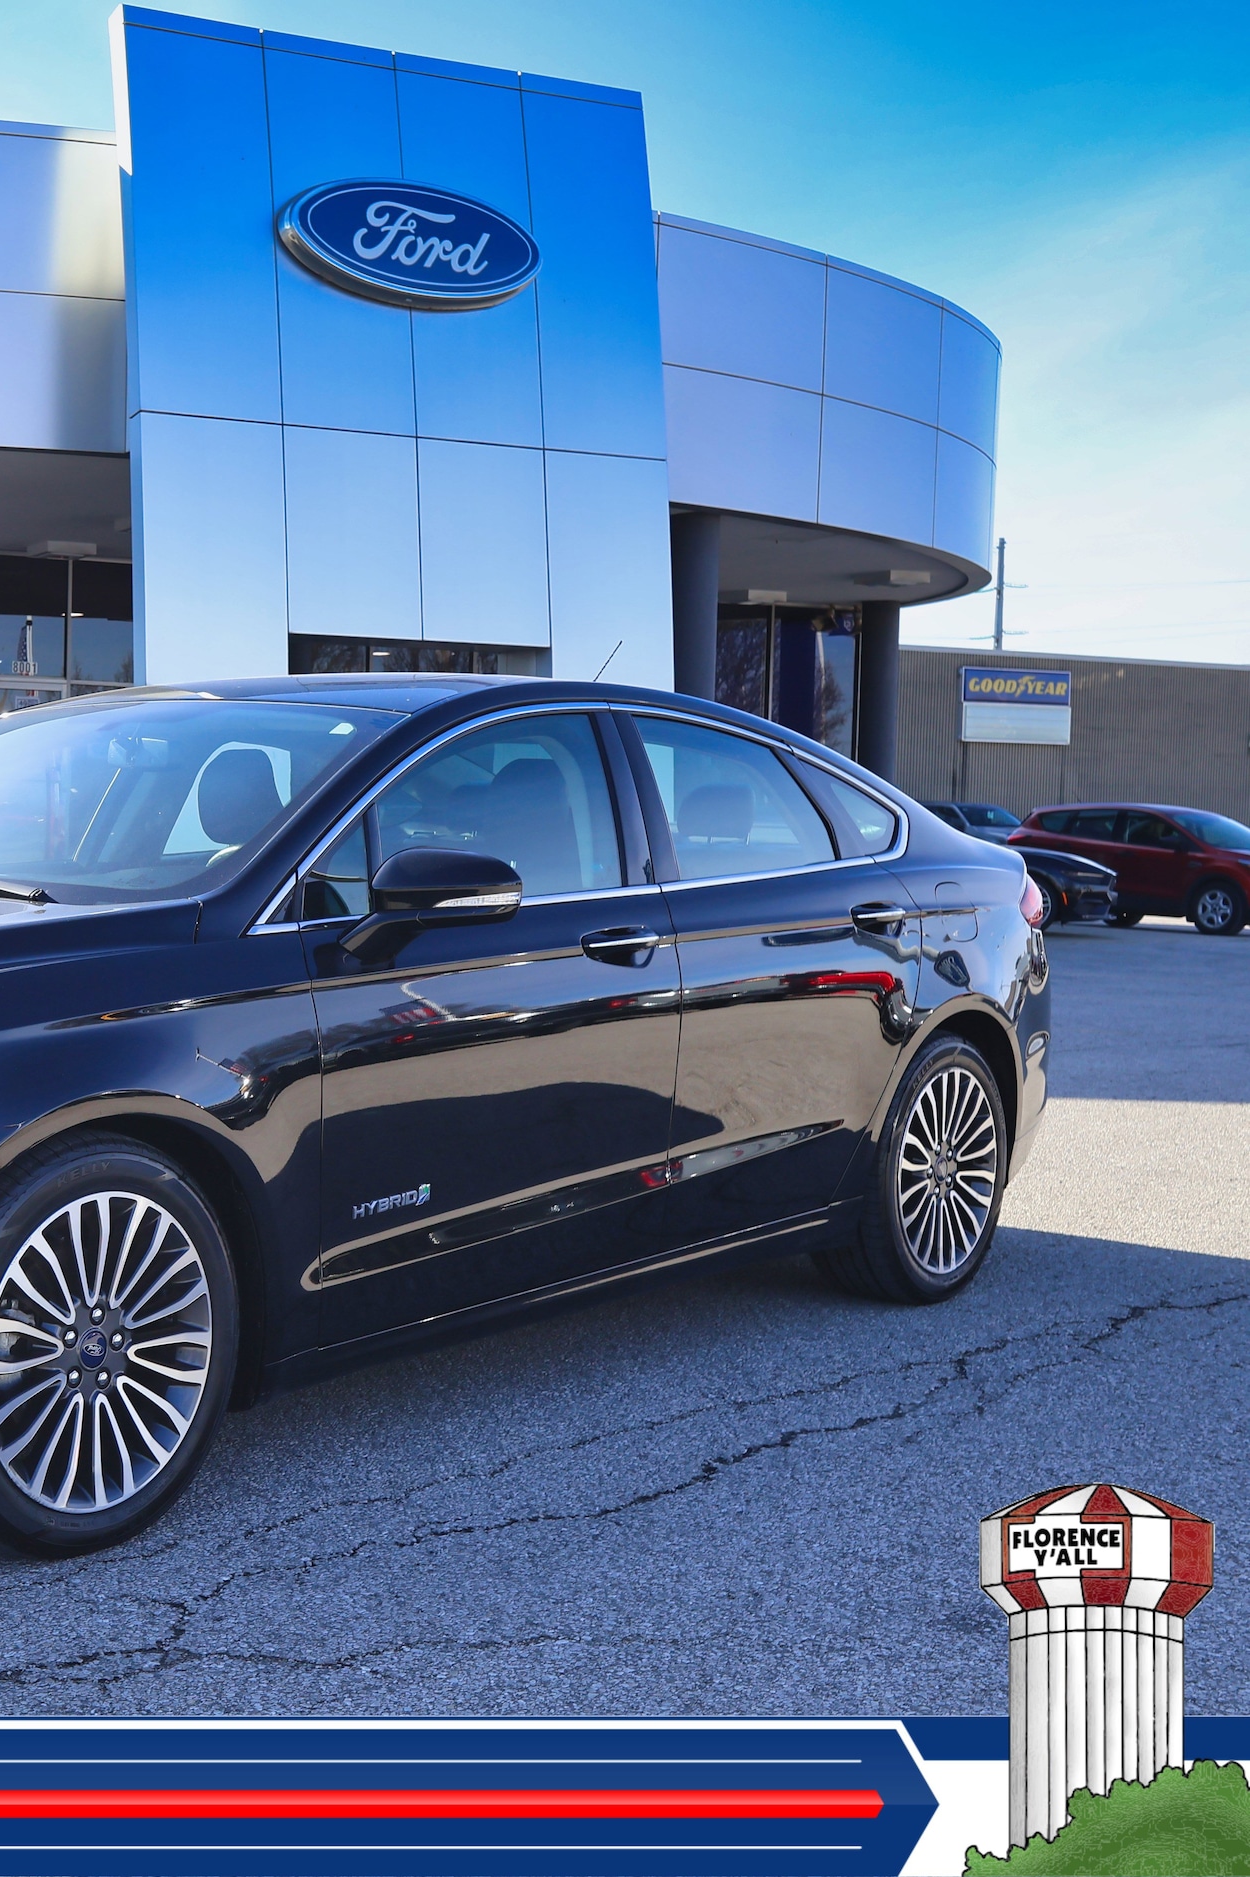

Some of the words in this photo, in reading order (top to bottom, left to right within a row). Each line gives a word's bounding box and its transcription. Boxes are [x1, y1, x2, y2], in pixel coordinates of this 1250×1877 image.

[353, 200, 491, 276] Ford
[12, 661, 37, 674] 8001
[968, 675, 1068, 698] GOODYEAR
[56, 1160, 111, 1188] KELLY
[352, 1189, 419, 1219] HYBRID
